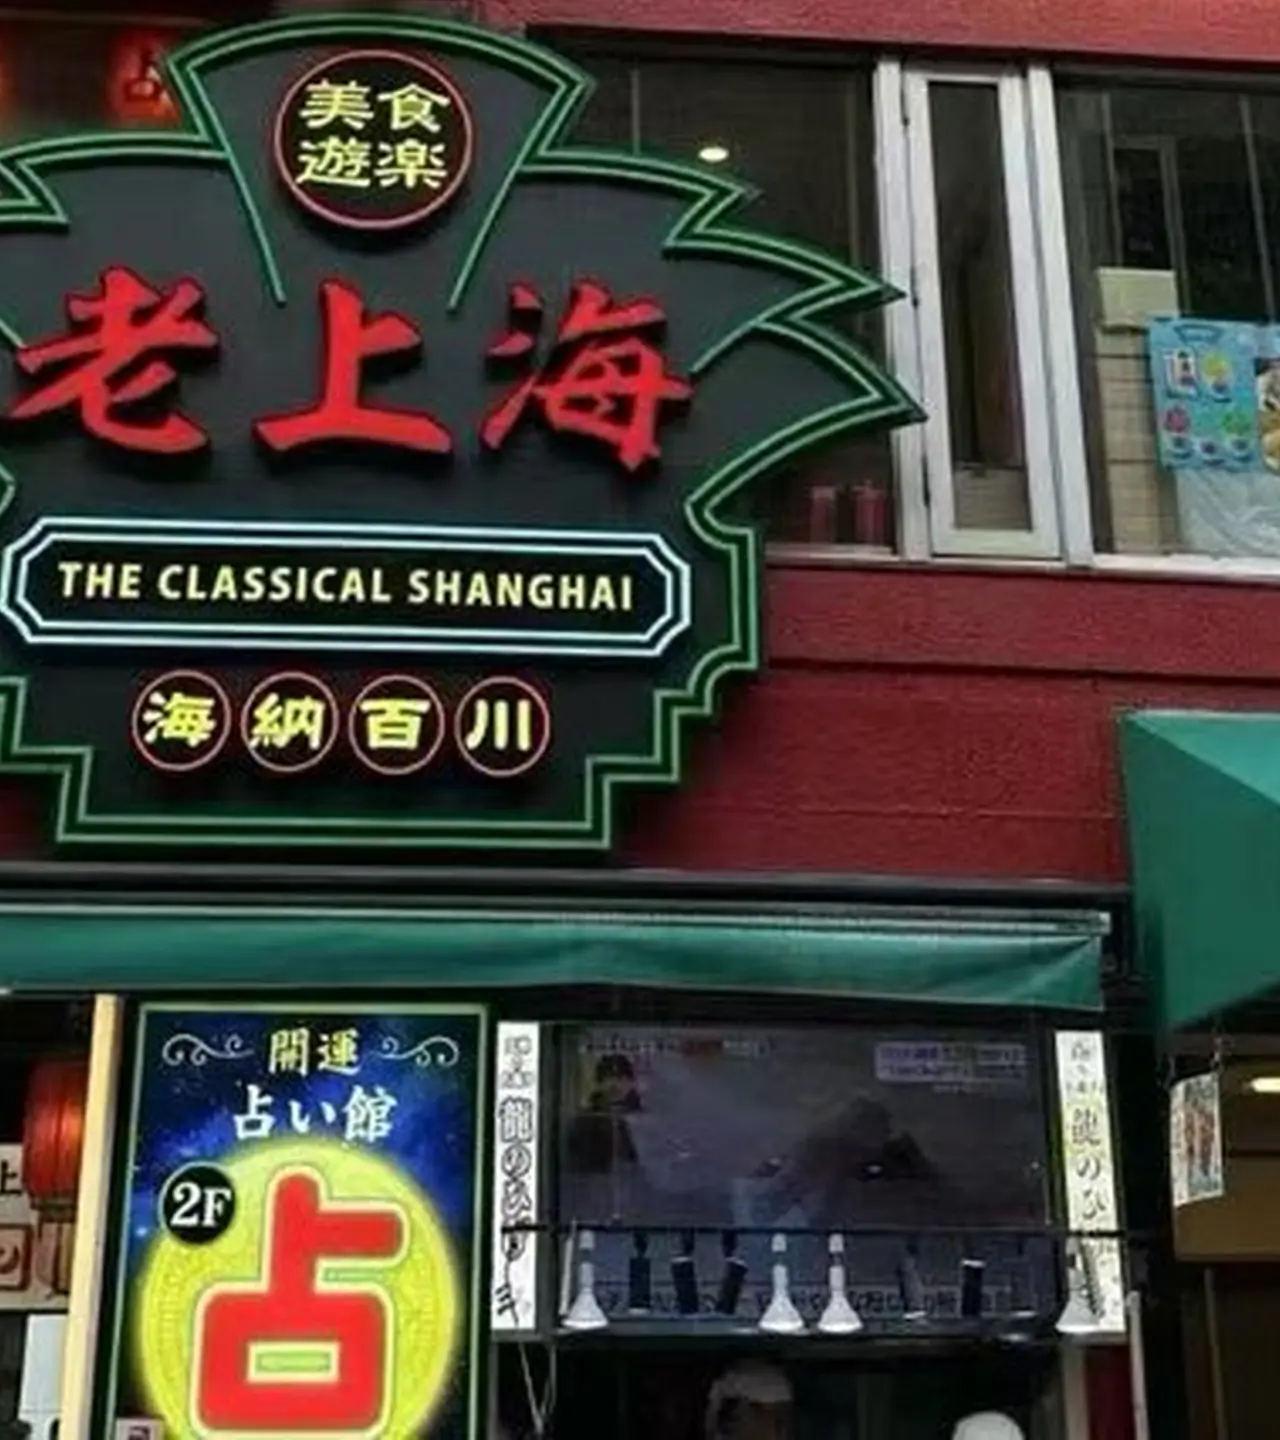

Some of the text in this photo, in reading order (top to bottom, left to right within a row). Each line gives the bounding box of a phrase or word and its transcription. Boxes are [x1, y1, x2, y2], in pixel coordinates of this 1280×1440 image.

[298, 78, 451, 133] 美食
[295, 135, 448, 189] 遊楽
[6, 266, 696, 471] 老上海
[58, 561, 633, 613] THE CLASSICAL SHANGHAI
[142, 691, 532, 750] 海納百川
[266, 1026, 362, 1078] 開運
[232, 1083, 399, 1142] 占い館
[170, 1181, 233, 1230] 2F
[194, 1167, 407, 1437] 占
